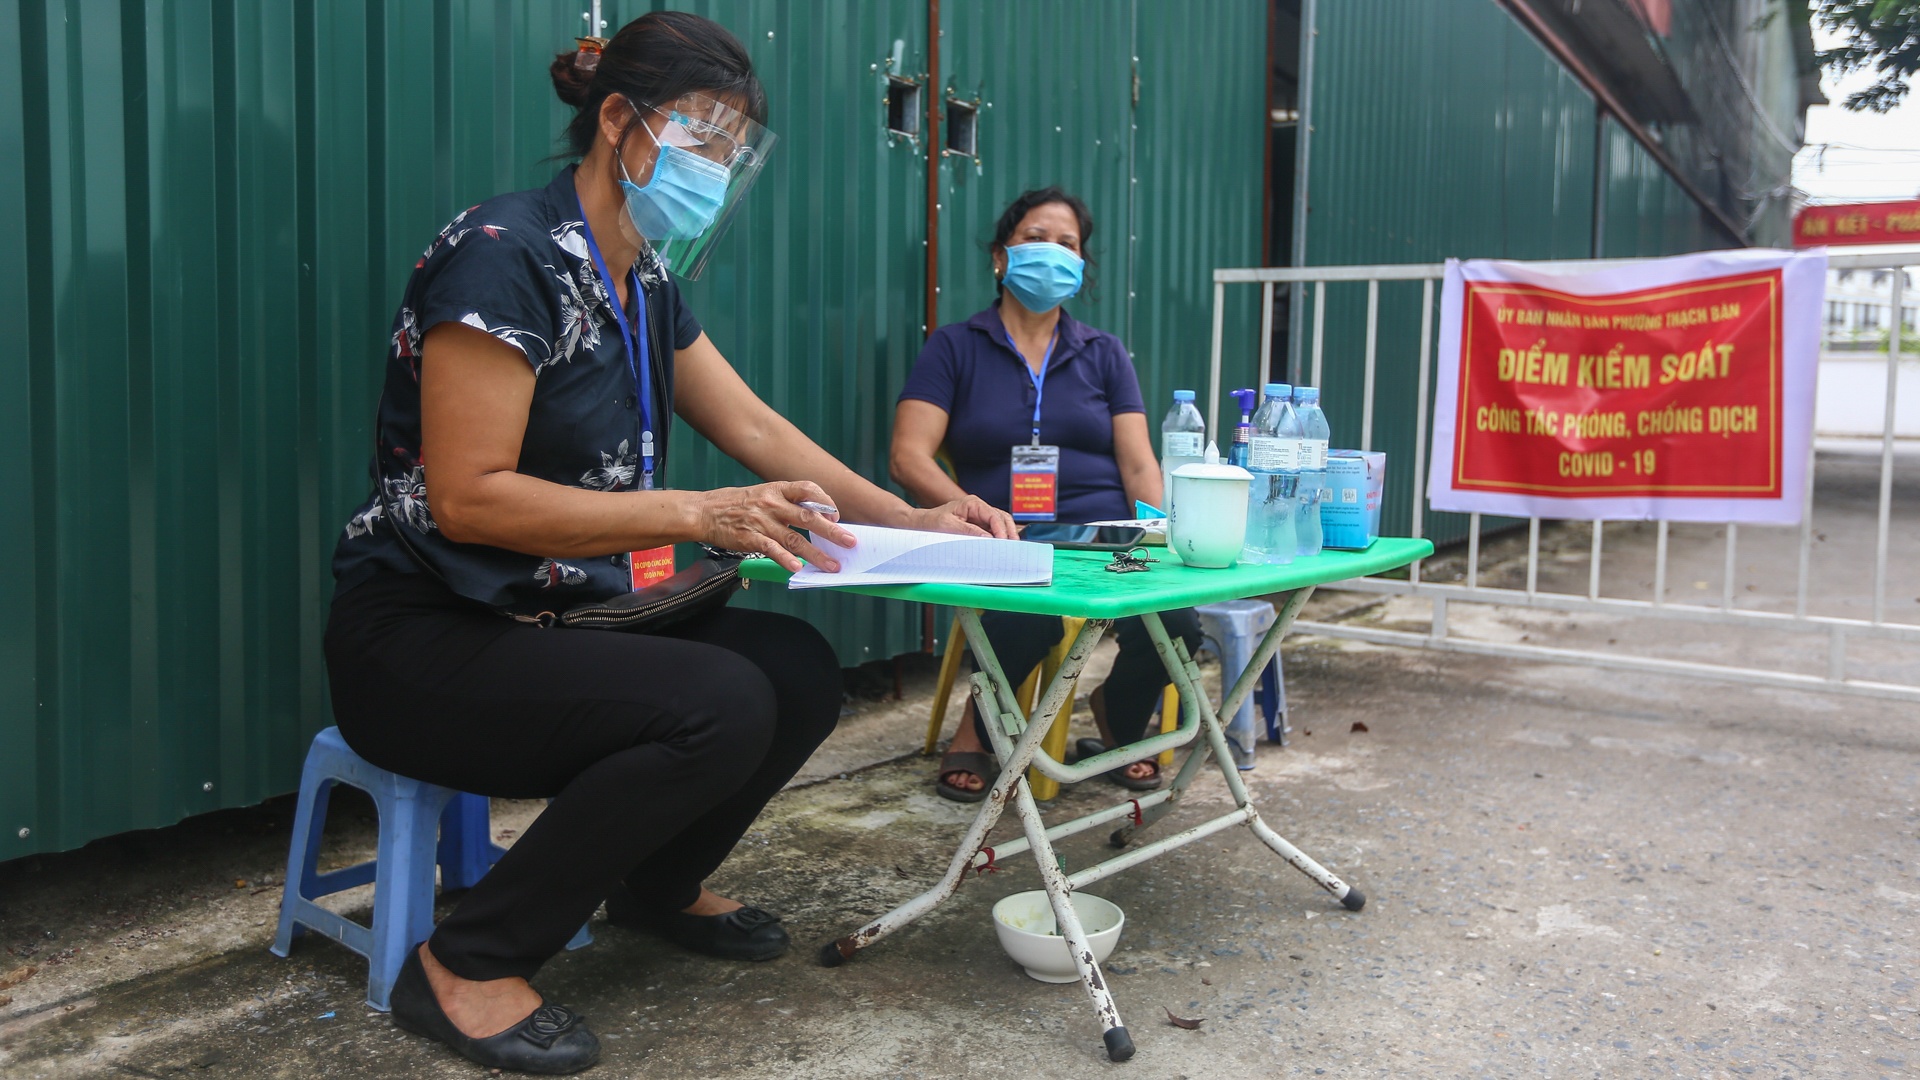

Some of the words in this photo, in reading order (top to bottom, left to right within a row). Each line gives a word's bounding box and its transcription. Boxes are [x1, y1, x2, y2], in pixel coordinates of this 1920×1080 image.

[1516, 309, 1544, 326] BAN
[1497, 338, 1570, 387] ĐIỂM
[1576, 342, 1650, 389] KIỂM
[1658, 340, 1735, 385] SOÁT
[1476, 402, 1521, 434] CÔNG
[1524, 402, 1558, 437] TÁC
[1562, 409, 1632, 440] PHÒNG,
[1637, 402, 1703, 436] CHỐNG
[1708, 405, 1758, 439] DỊCH
[1558, 451, 1614, 478] COVID
[1632, 448, 1656, 476] 19
